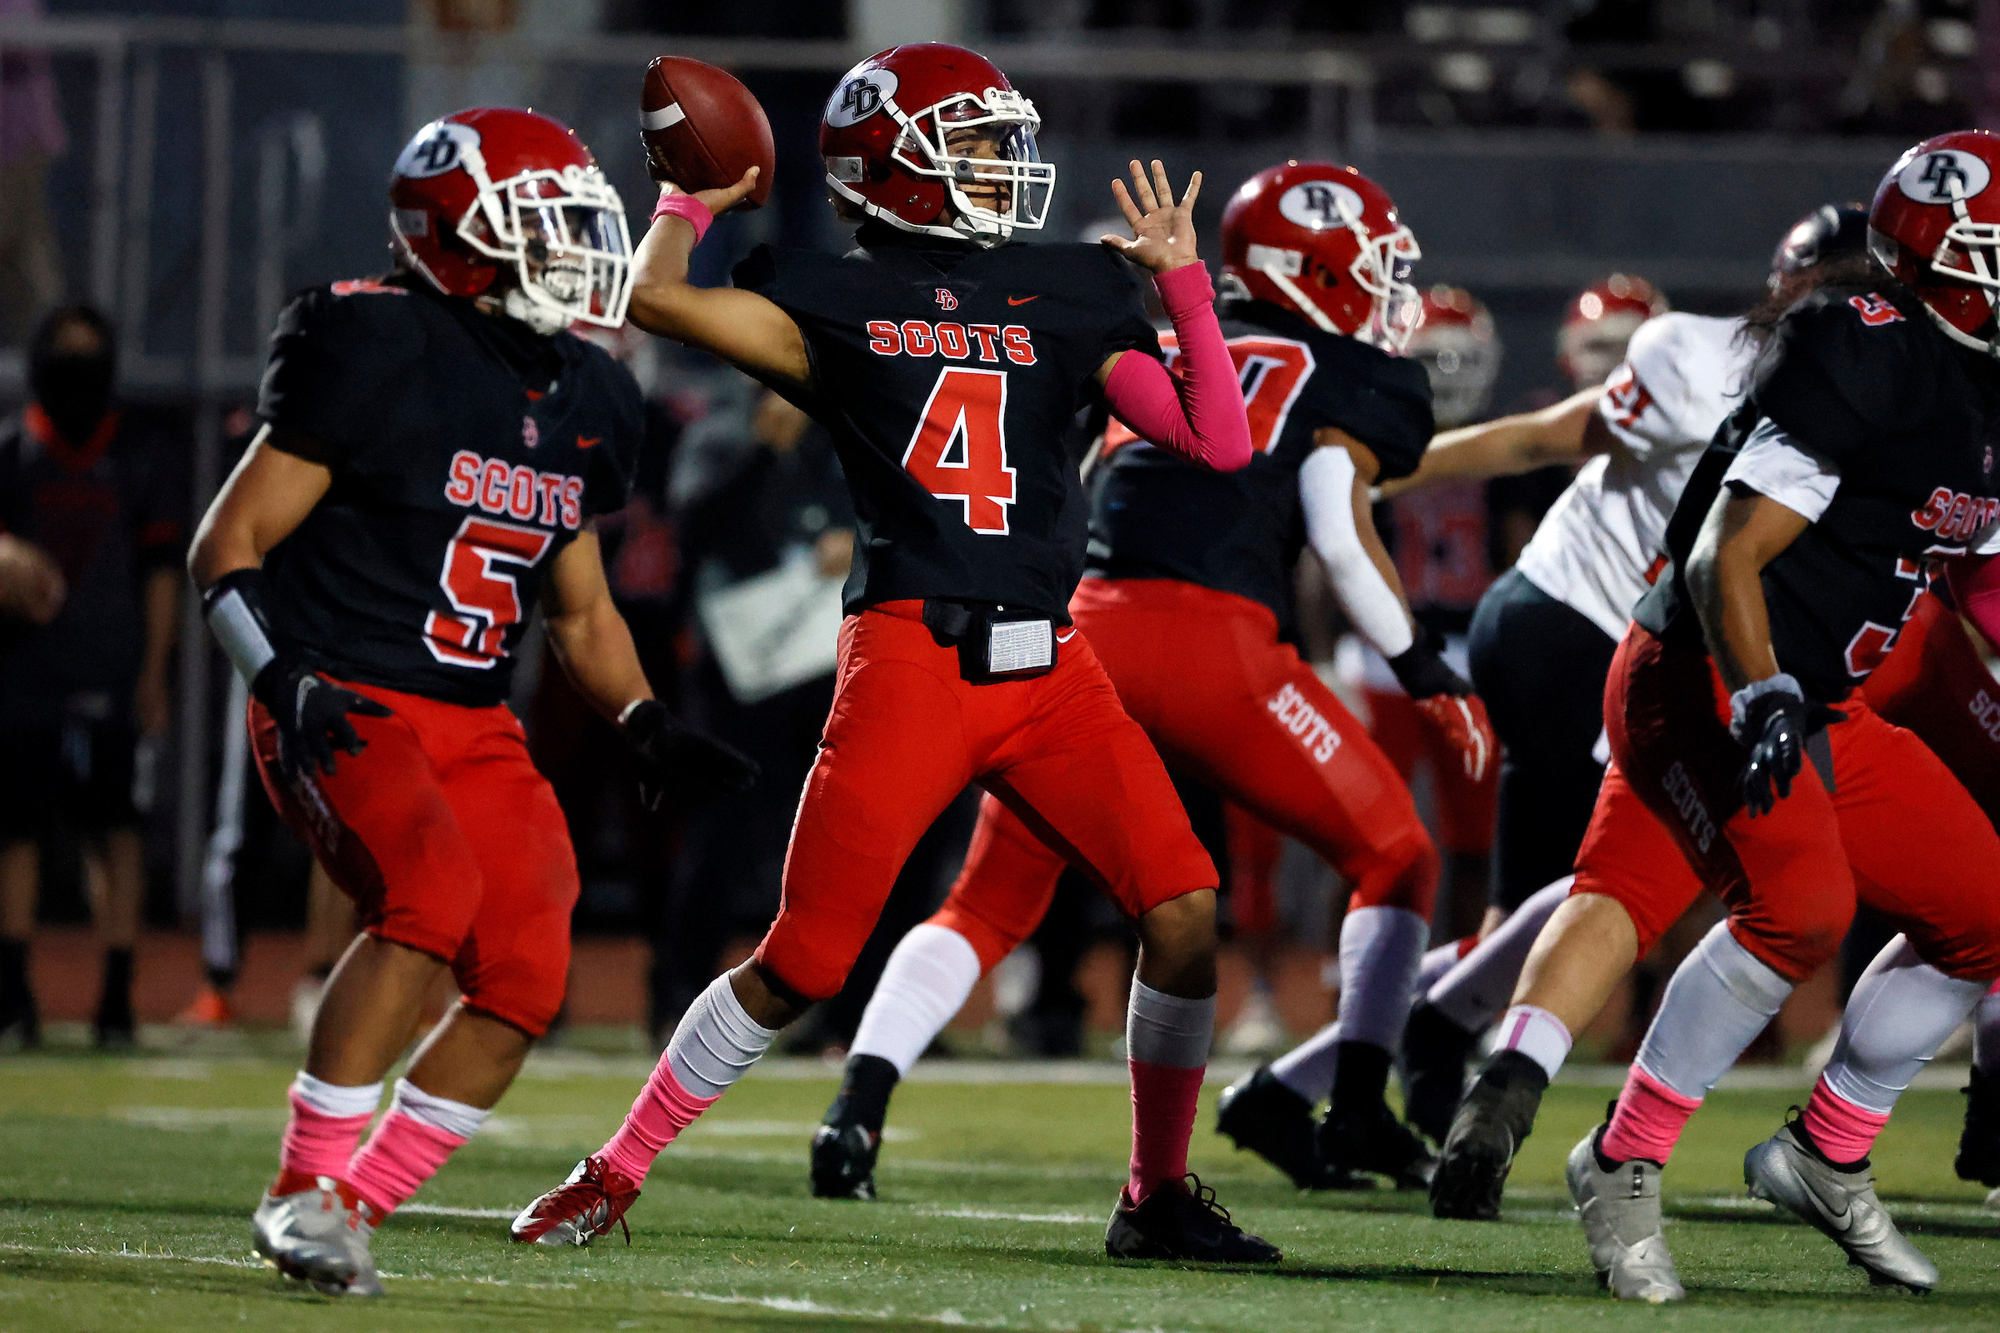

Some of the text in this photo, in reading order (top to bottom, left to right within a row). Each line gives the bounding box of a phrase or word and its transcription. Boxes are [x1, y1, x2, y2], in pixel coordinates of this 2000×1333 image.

[866, 319, 1038, 366] SCOTS
[445, 449, 585, 530] SCOTS
[901, 365, 1017, 536] 4
[422, 514, 556, 670] 5
[1267, 682, 1342, 763] SCOTS
[1661, 760, 1717, 854] SCOTS
